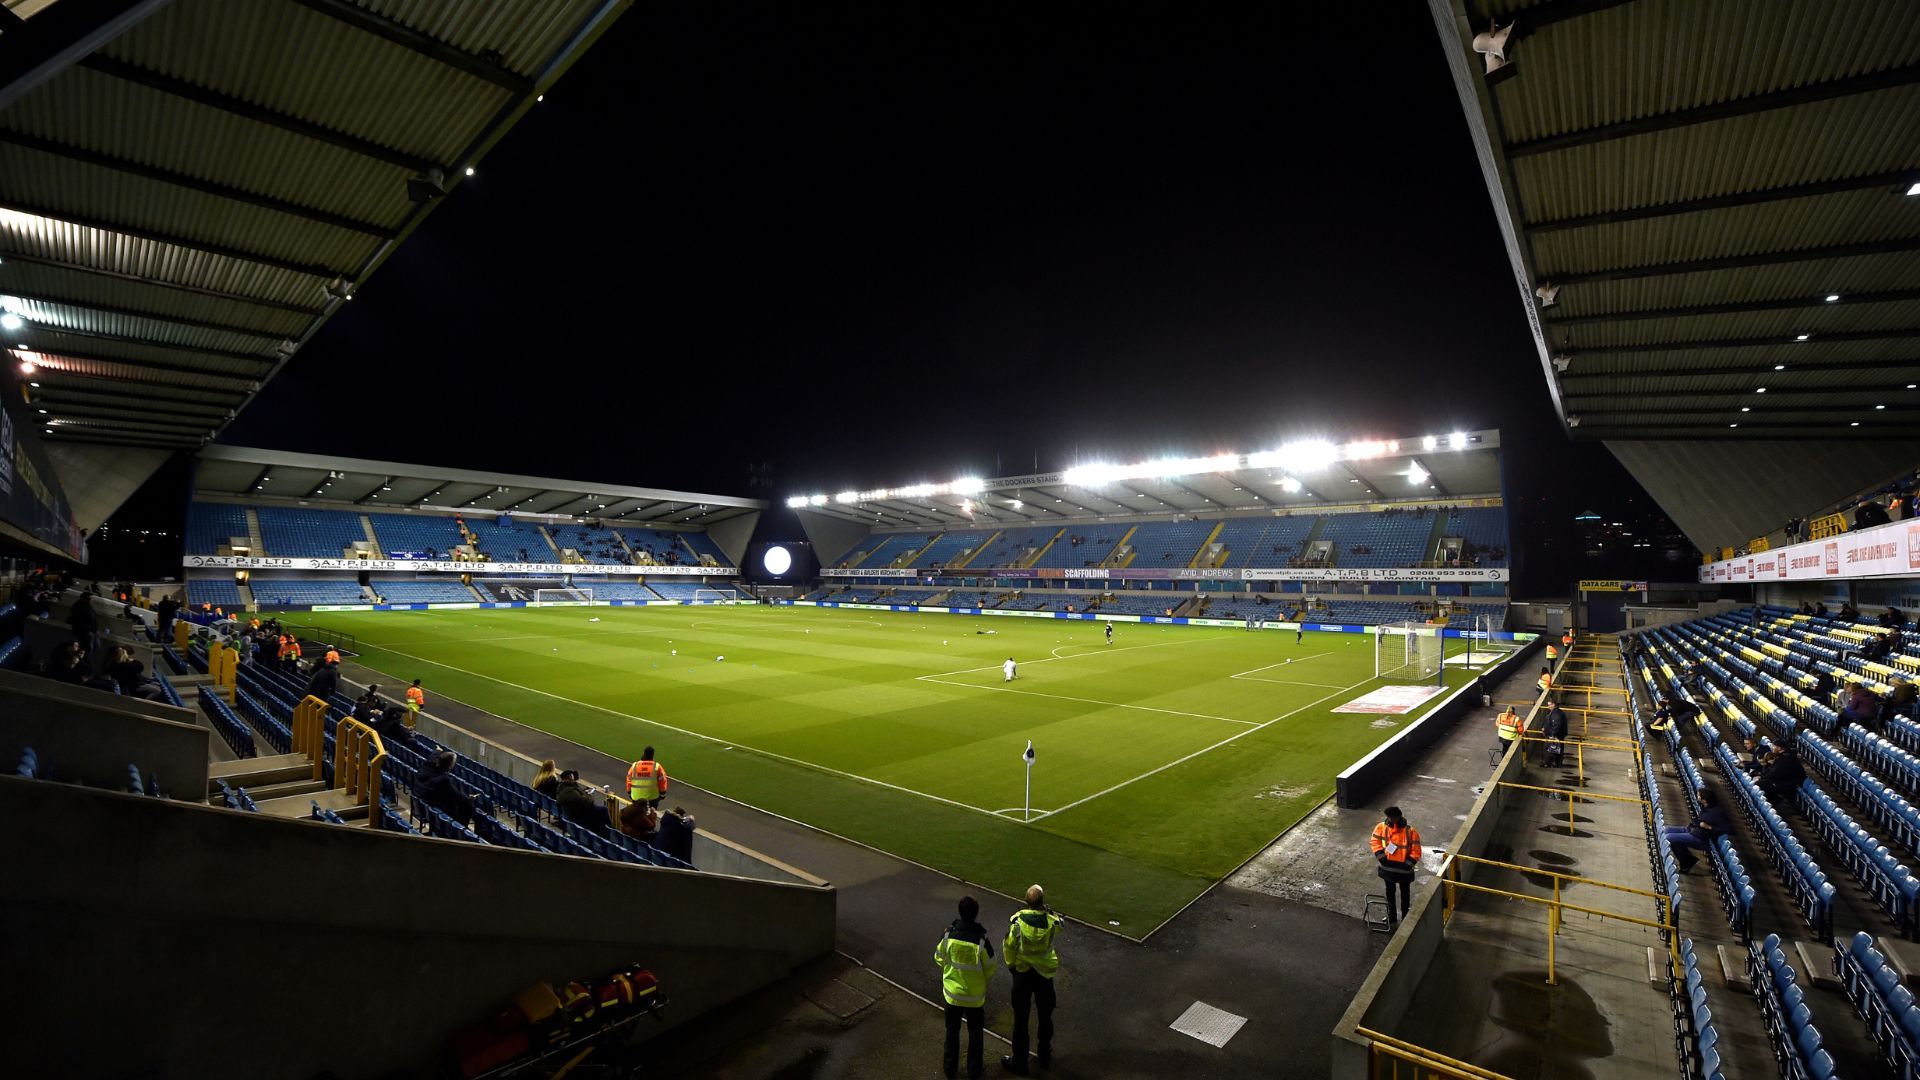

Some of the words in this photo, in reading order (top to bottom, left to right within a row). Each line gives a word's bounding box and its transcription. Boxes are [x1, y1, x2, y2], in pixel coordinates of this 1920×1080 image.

[1006, 478, 1036, 486] DOCKERS
[1036, 476, 1058, 484] STAND
[1064, 569, 1109, 578] SCAFFOLDING
